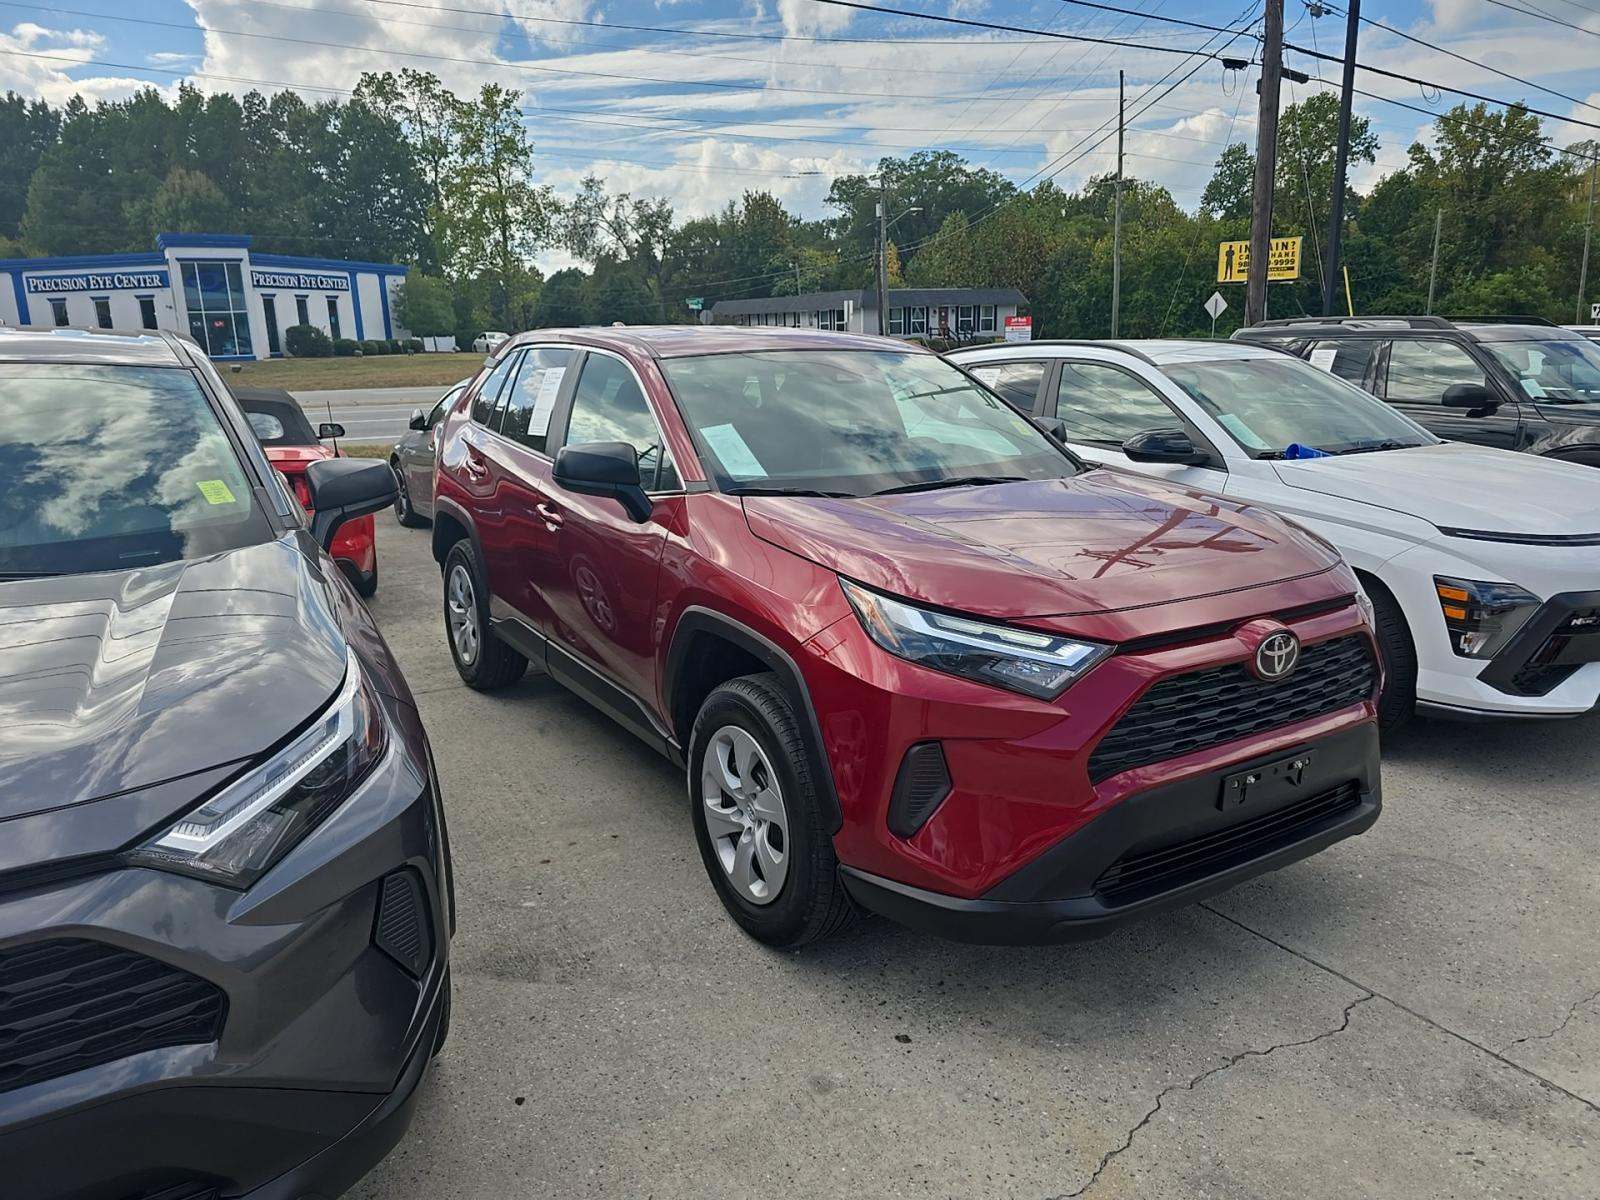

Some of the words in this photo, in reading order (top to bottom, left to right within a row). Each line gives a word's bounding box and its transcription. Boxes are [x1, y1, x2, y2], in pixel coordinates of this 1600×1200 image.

[28, 277, 88, 292] PRECISION
[88, 275, 114, 290] EYE
[114, 273, 163, 288] CENTER
[252, 272, 299, 287] PRECISION
[300, 275, 317, 289] EYE
[317, 275, 349, 290] CENTER
